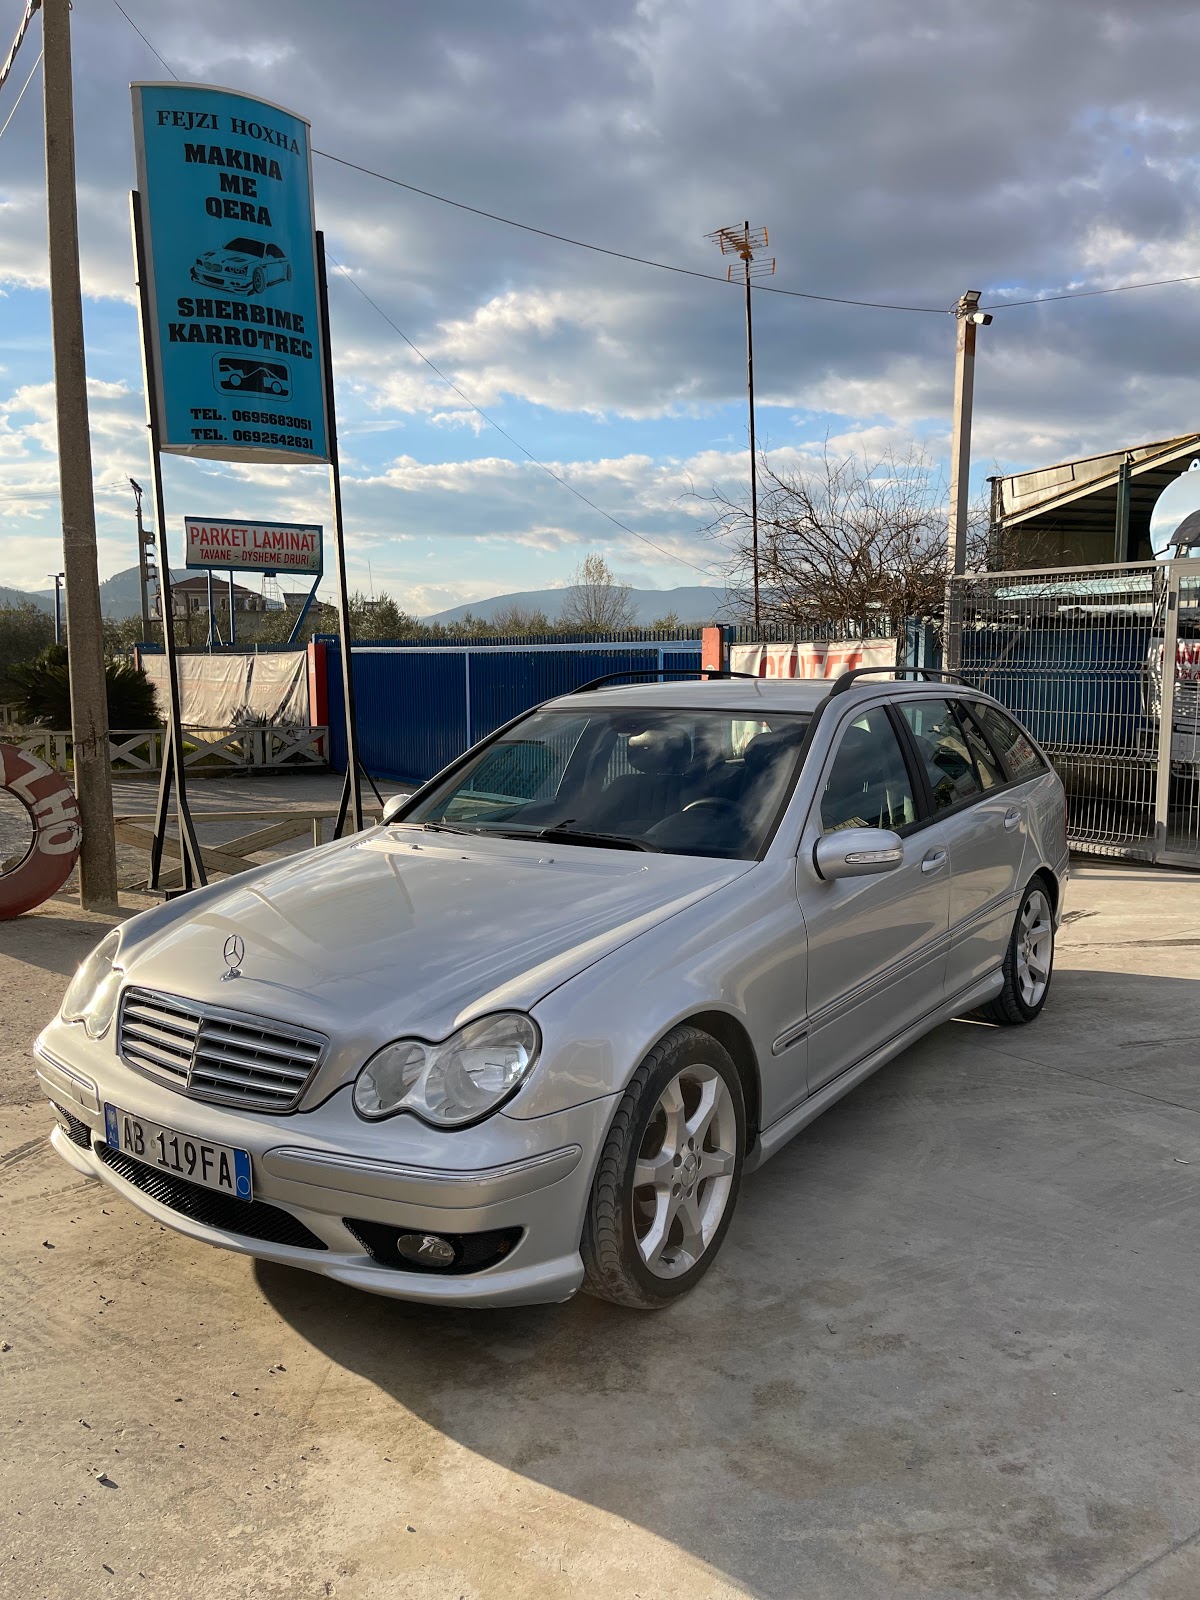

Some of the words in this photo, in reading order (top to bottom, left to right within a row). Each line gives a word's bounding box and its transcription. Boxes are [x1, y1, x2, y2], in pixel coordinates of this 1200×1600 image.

[156, 110, 219, 131] FEJZI
[230, 117, 301, 156] HOXHA
[184, 143, 283, 181] MAKINA
[219, 172, 258, 198] ME
[205, 196, 272, 227] QERA
[177, 297, 305, 334] SHERBIME
[168, 323, 313, 360] KARROTREC
[190, 408, 227, 422] TEL.
[232, 409, 312, 431] 0695683051
[191, 428, 228, 441] TEL.
[233, 429, 313, 450] 0692542631
[189, 526, 248, 547] PARKET
[253, 530, 317, 552] LAMINAT
[199, 548, 231, 560] TAVANE
[242, 551, 282, 563] DYSHEME
[284, 554, 309, 565] DRURI
[123, 1116, 145, 1156] AB
[156, 1130, 233, 1189] 119FA
